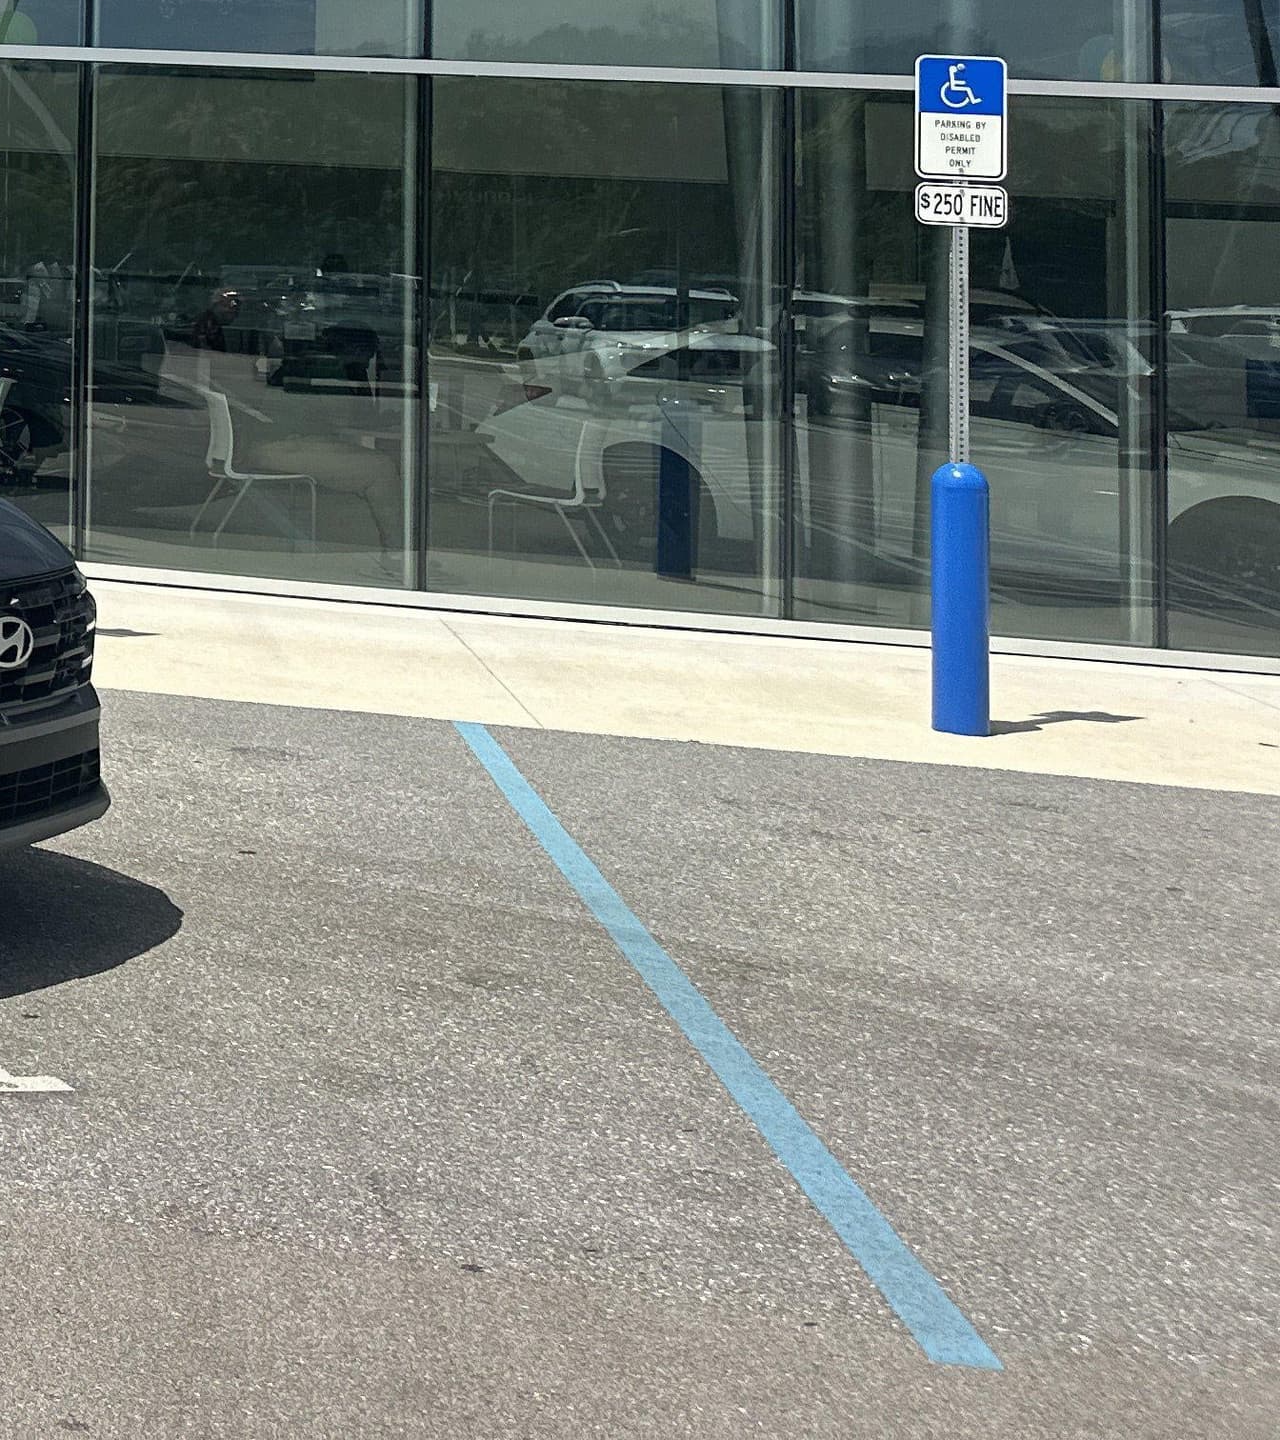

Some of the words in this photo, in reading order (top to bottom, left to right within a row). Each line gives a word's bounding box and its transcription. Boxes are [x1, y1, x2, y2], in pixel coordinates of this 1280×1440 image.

[935, 119, 971, 129] PARKING
[975, 122, 986, 130] BY
[940, 133, 981, 143] DISABLED
[945, 146, 976, 155] PERMIT
[949, 159, 971, 168] ONLY
[920, 192, 964, 216] $250
[970, 195, 1003, 218] FINE
